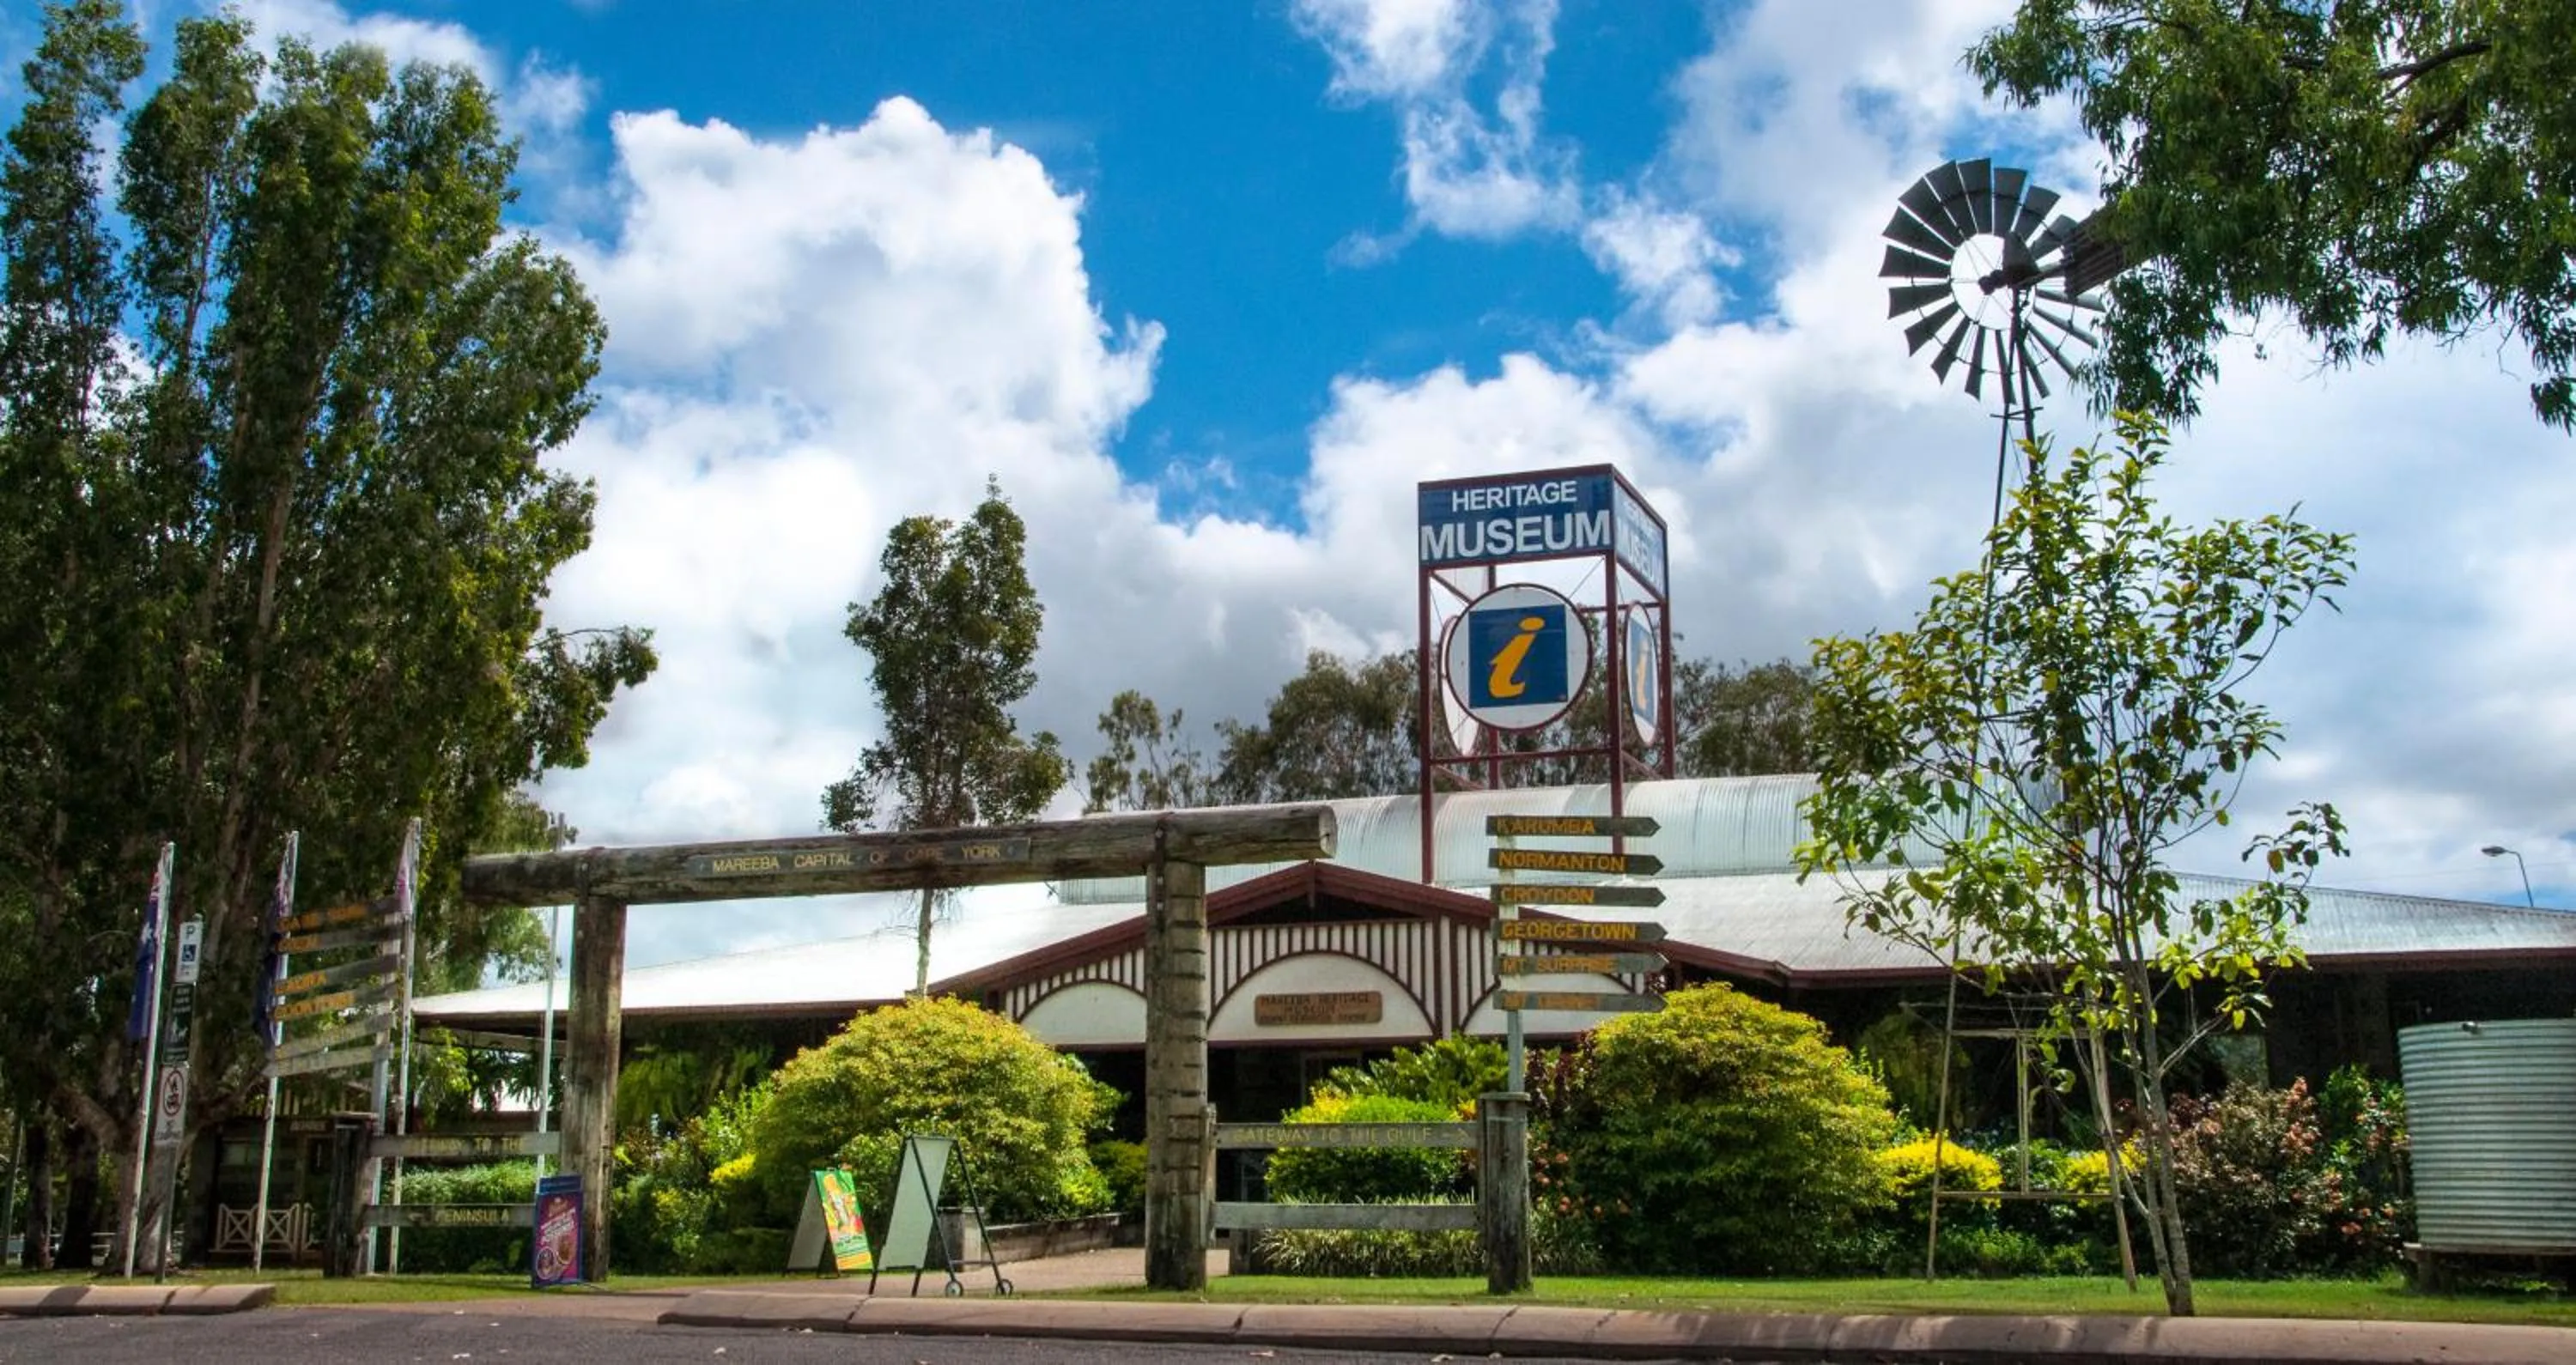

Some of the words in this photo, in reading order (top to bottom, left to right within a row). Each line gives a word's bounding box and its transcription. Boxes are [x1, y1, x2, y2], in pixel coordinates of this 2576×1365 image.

[1452, 481, 1577, 513] HERITAGE
[1421, 510, 1611, 560] MUSEUM
[1497, 818, 1595, 834] KARUMBA
[713, 854, 780, 873] MAREEBA
[793, 850, 854, 869] CAPITAL
[870, 849, 890, 864] OF
[905, 846, 944, 862] CAPE
[961, 844, 1001, 859] YORK
[1498, 851, 1625, 871] NORMANTON
[1501, 887, 1595, 904] CROYDON
[1503, 921, 1636, 940] GEORGETOWN
[1504, 957, 1527, 974] MT
[1537, 955, 1616, 974] SURPRISE
[1236, 1127, 1312, 1144] GATEWAY
[1321, 1127, 1341, 1142] TO
[1387, 1126, 1431, 1142] GULF
[434, 1208, 510, 1223] PENINSULA
